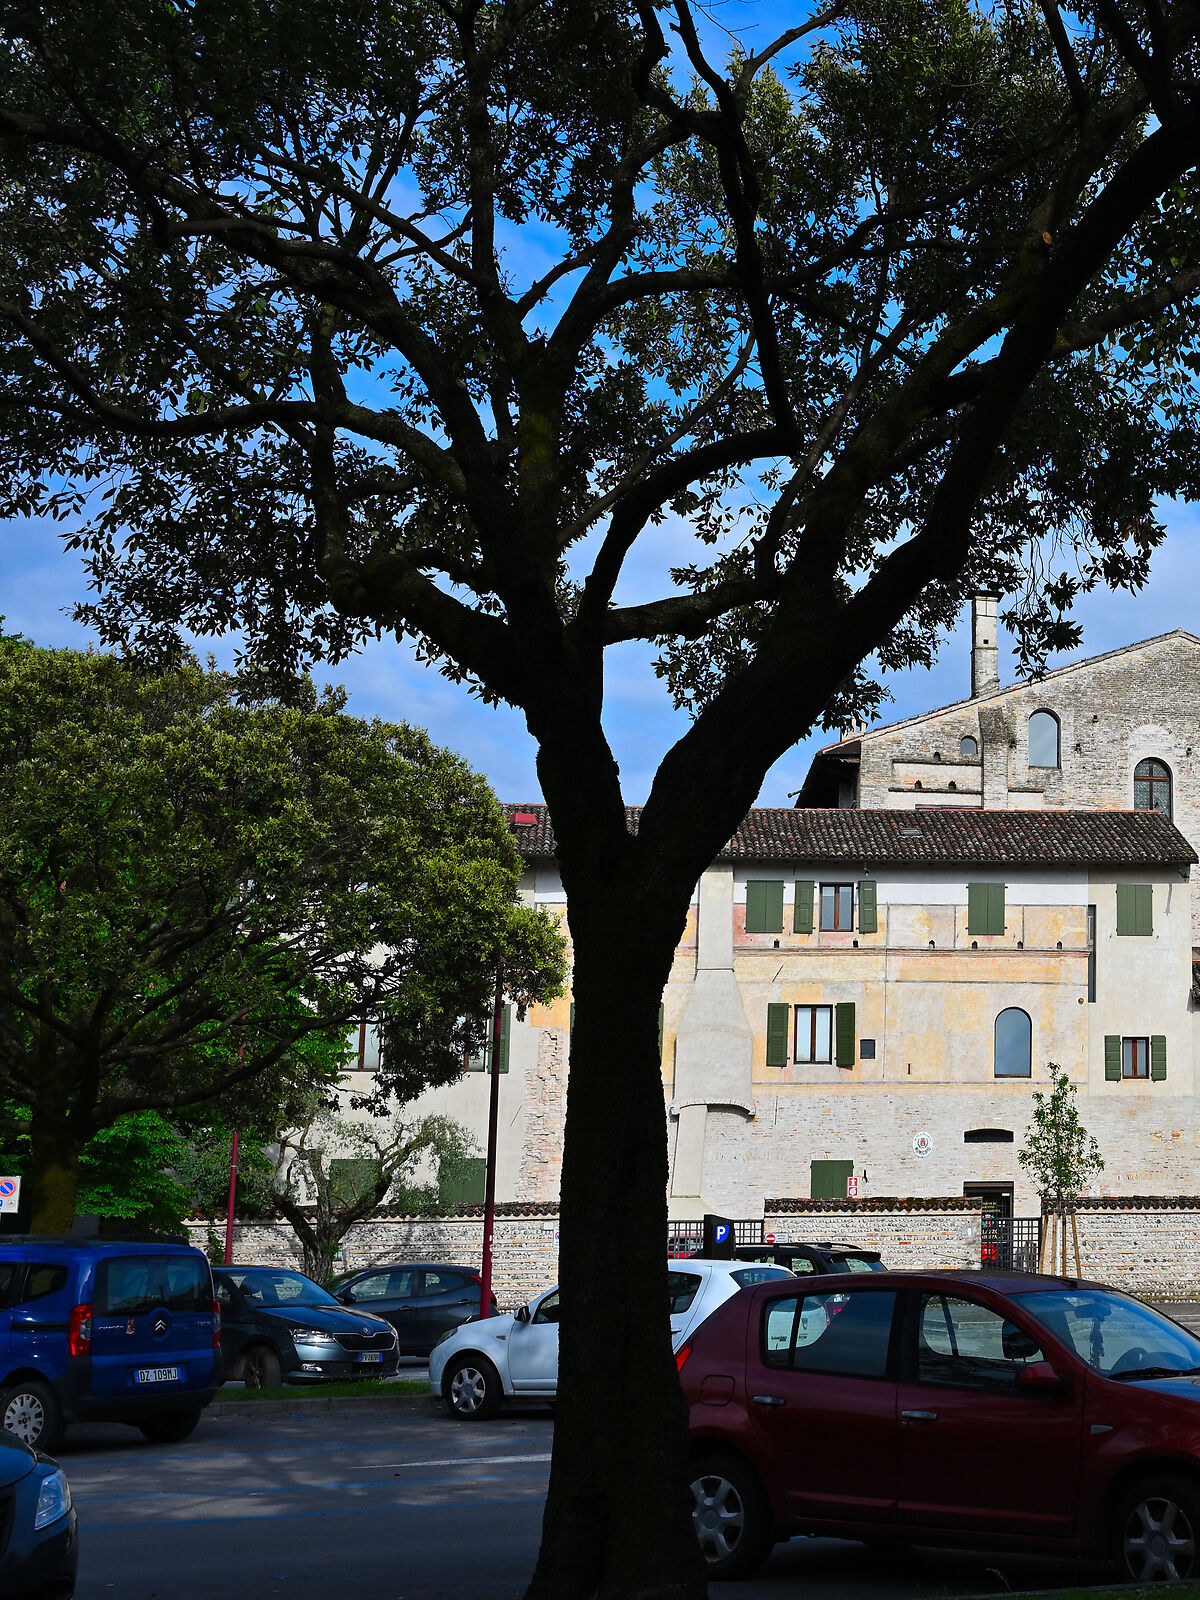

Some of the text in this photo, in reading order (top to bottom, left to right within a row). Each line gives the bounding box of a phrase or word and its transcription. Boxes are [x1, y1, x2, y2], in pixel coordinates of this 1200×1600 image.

[717, 1226, 726, 1240] P
[139, 1369, 177, 1382] DZ 109MJ
